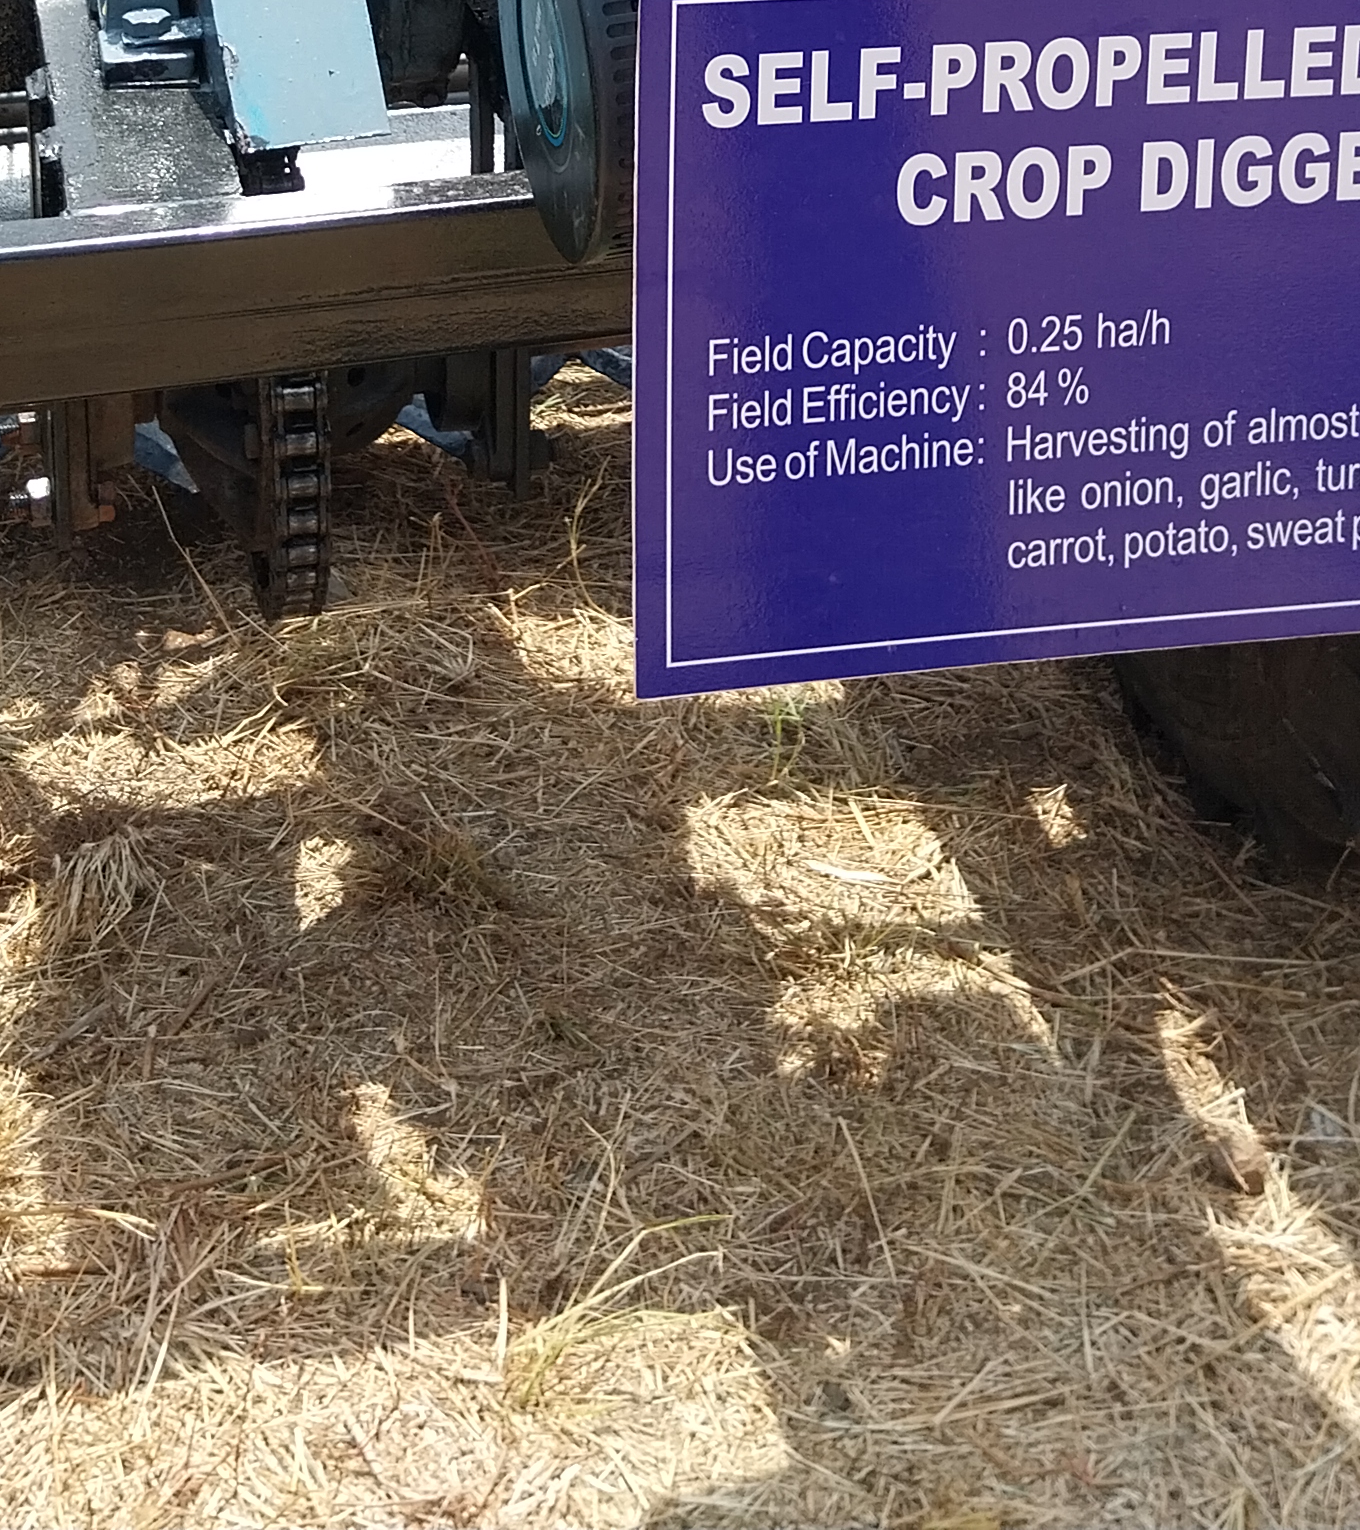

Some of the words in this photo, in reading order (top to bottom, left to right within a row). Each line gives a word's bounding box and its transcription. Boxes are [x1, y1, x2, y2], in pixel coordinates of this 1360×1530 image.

[897, 141, 1111, 225] CROP
[709, 334, 792, 376] Field
[803, 326, 956, 375] Capacity
[1008, 313, 1082, 355] 0.25
[1097, 308, 1170, 350] ha/h
[709, 388, 791, 431] Field
[803, 381, 970, 424] Efficiency
[1007, 371, 1049, 409] 84
[1057, 366, 1089, 406] %
[709, 448, 776, 486] Use
[785, 441, 820, 479] of
[1007, 416, 1188, 461] Harvesting
[1204, 409, 1238, 448] of
[1247, 404, 1360, 445] almost
[1009, 479, 1066, 516] like
[1081, 471, 1183, 514] onion,
[1200, 462, 1299, 510] garlic,
[1007, 528, 1114, 569] carrot,
[1124, 520, 1238, 569] potato,
[1246, 517, 1346, 550] sweat
